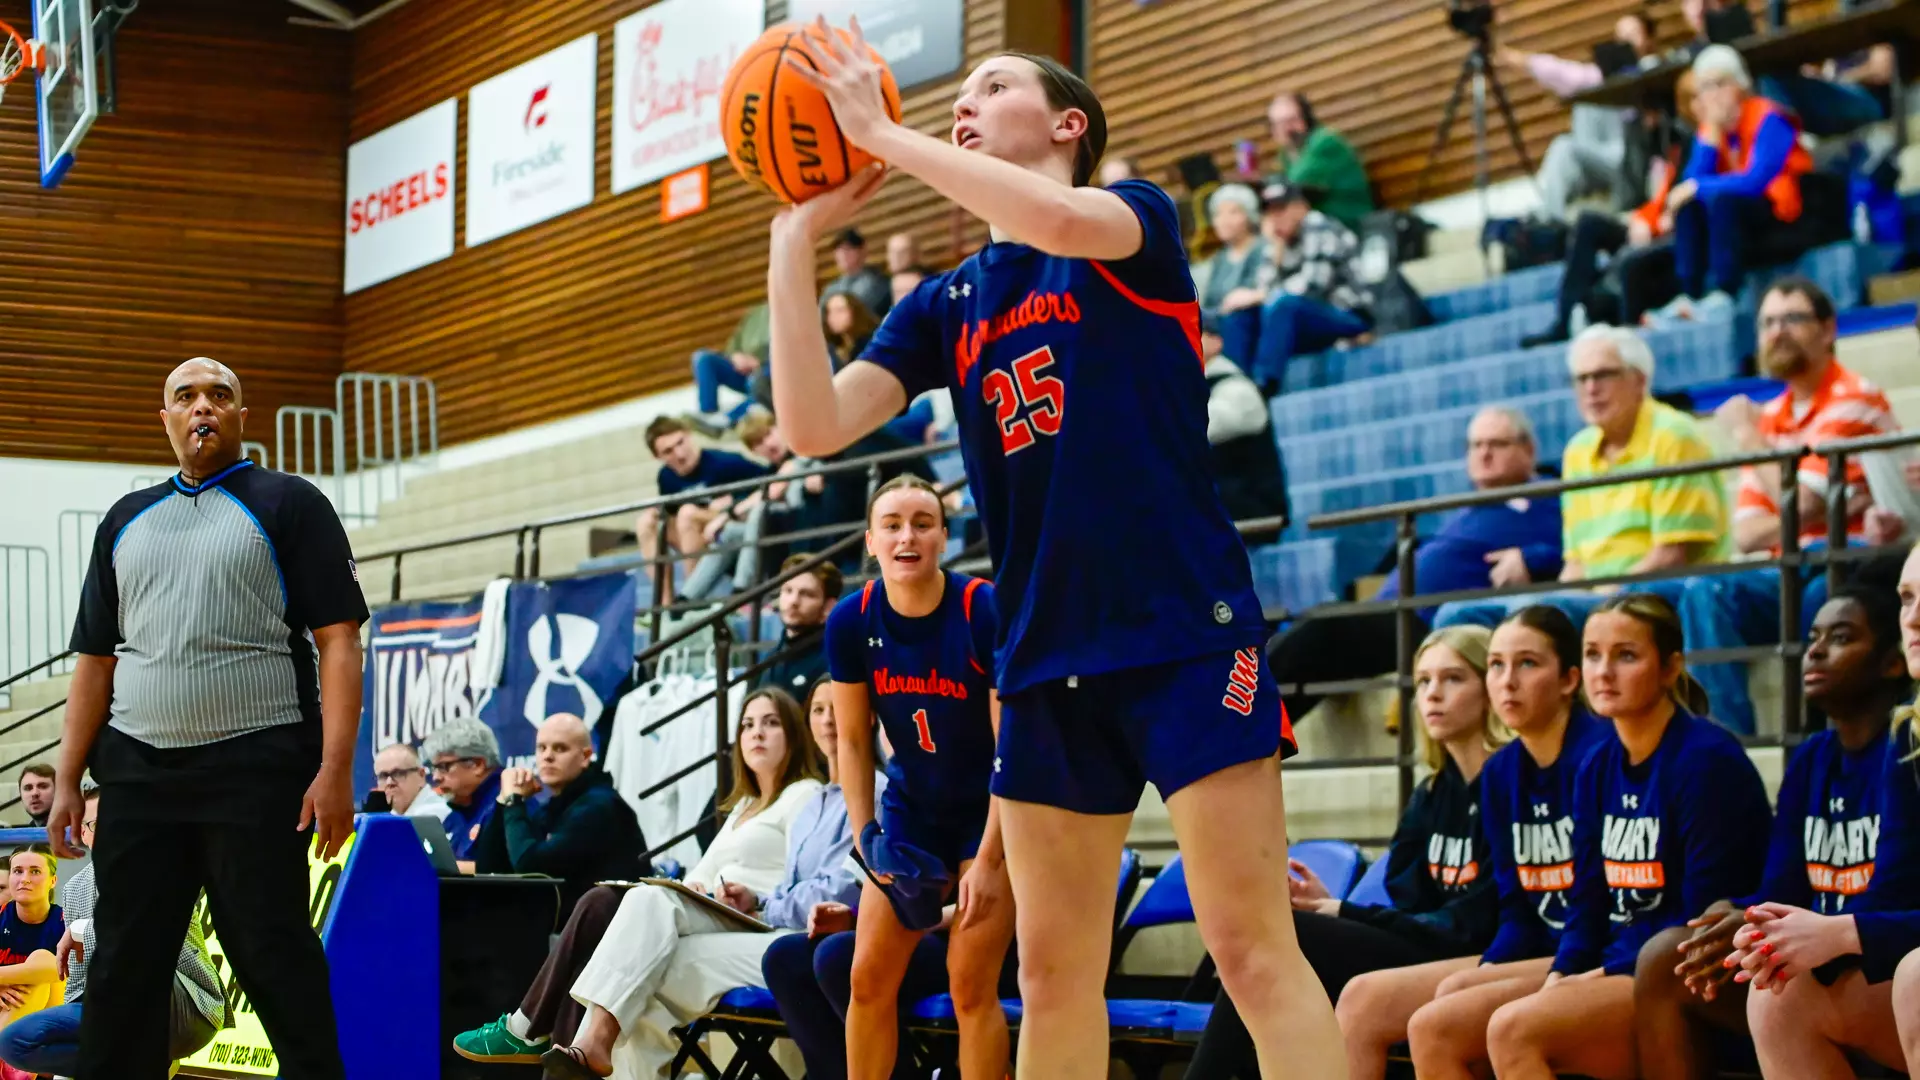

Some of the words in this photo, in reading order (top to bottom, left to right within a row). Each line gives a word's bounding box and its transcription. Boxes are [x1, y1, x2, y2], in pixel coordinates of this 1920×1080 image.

[349, 161, 448, 236] SCHEELS
[982, 344, 1064, 457] 25
[376, 648, 478, 752] UMAR
[873, 667, 968, 700] Marauders
[912, 708, 936, 753] 1
[1804, 813, 1881, 867] UMARY
[208, 1041, 233, 1065] (701)
